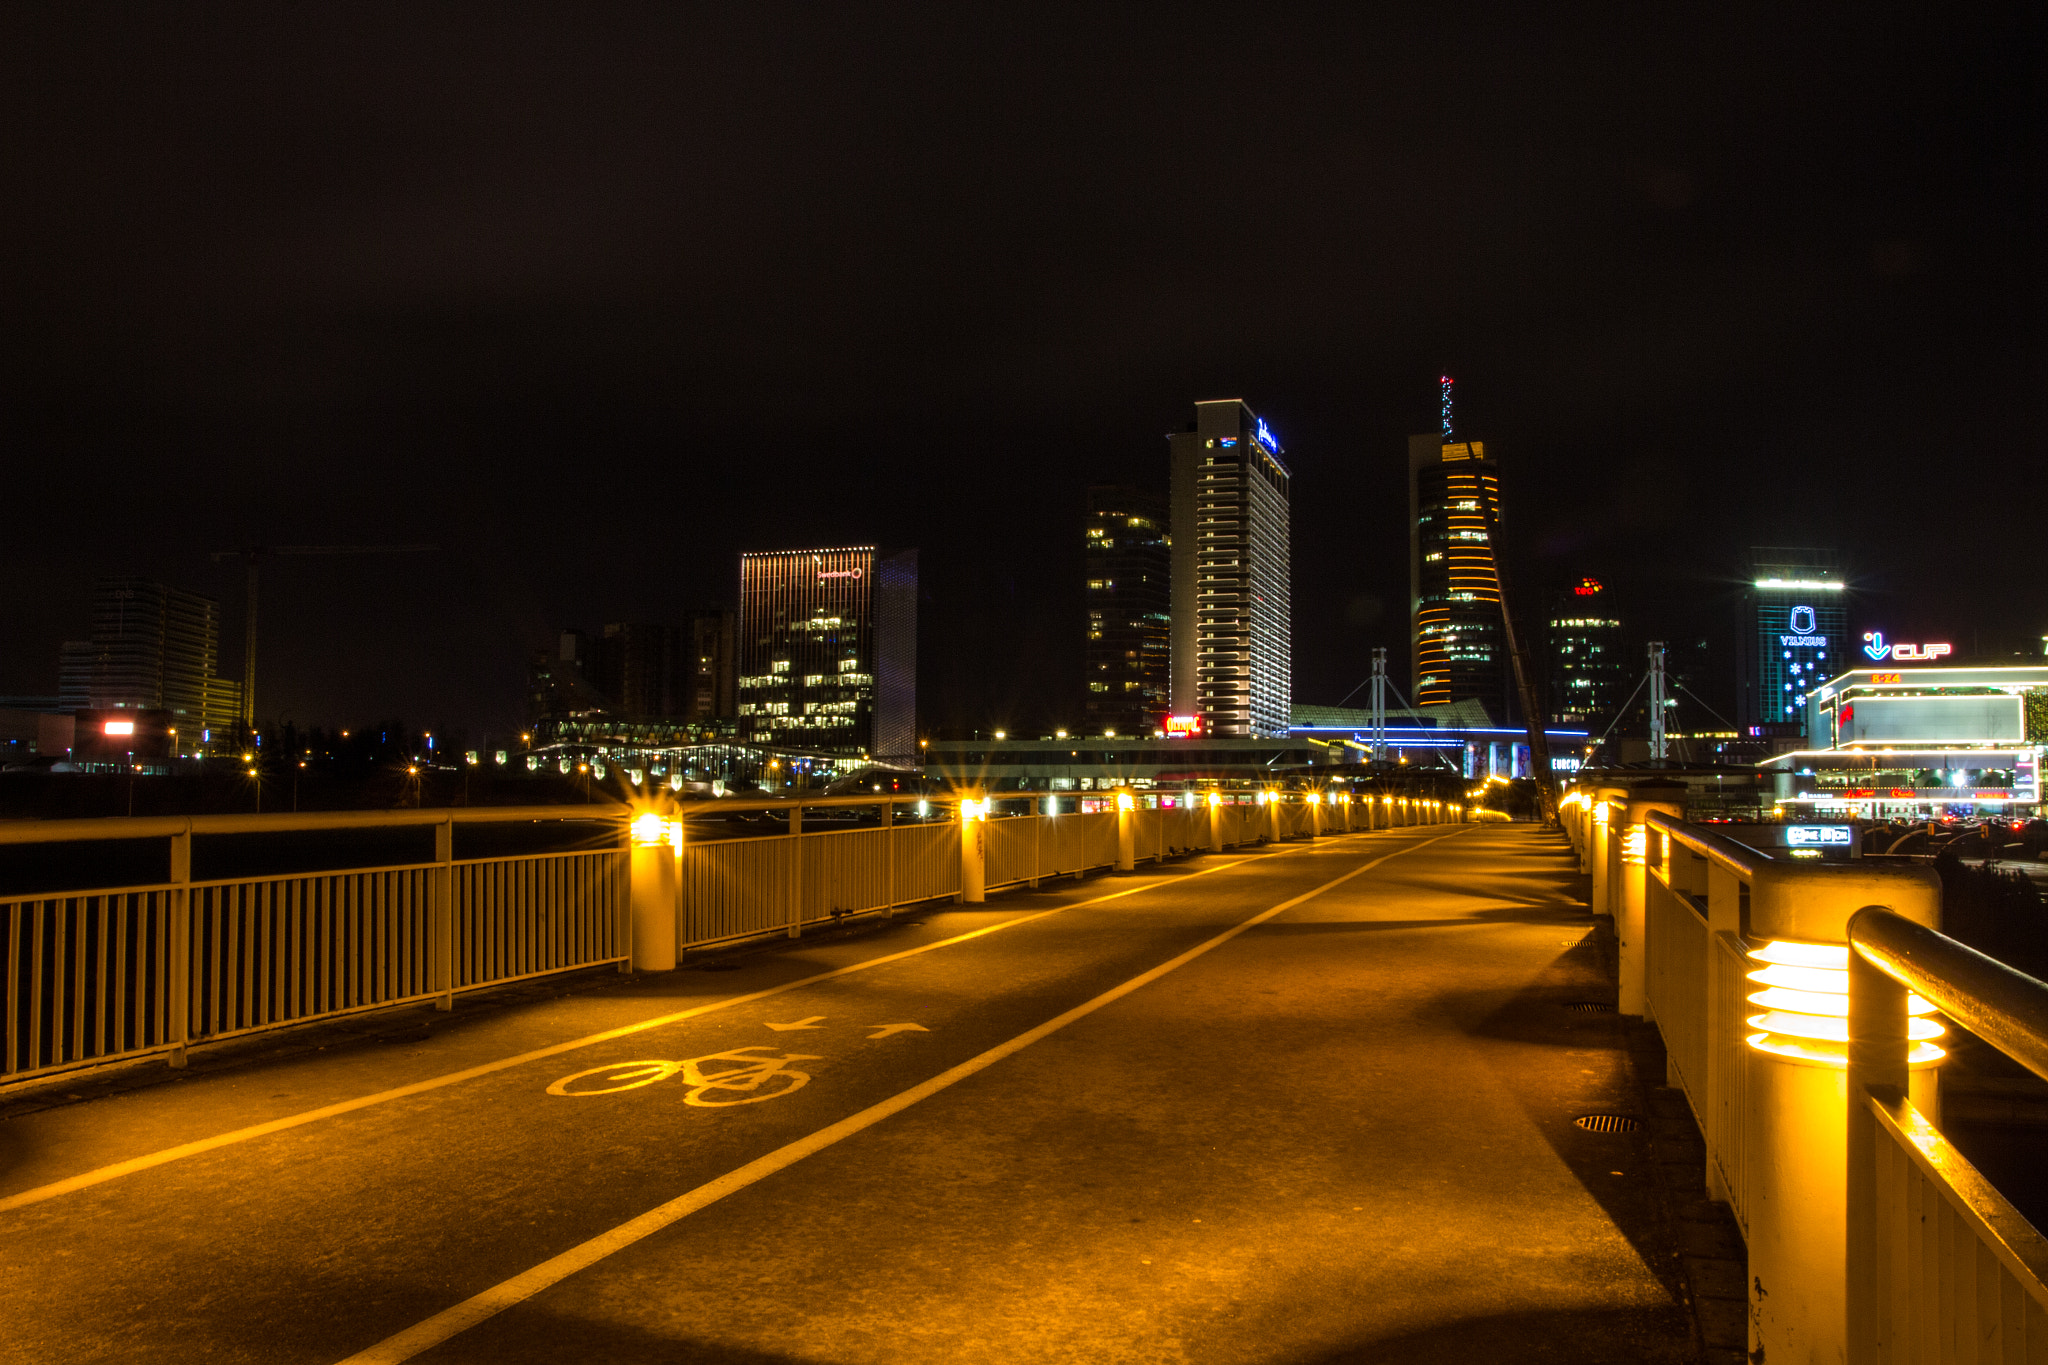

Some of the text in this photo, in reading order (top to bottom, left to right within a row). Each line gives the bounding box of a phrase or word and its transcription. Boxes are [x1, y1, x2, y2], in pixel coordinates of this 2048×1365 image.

[817, 570, 851, 579] Swedbank
[1780, 636, 1827, 647] VILNIUS
[1892, 644, 1951, 660] CUP
[1871, 673, 1901, 684] 8-24
